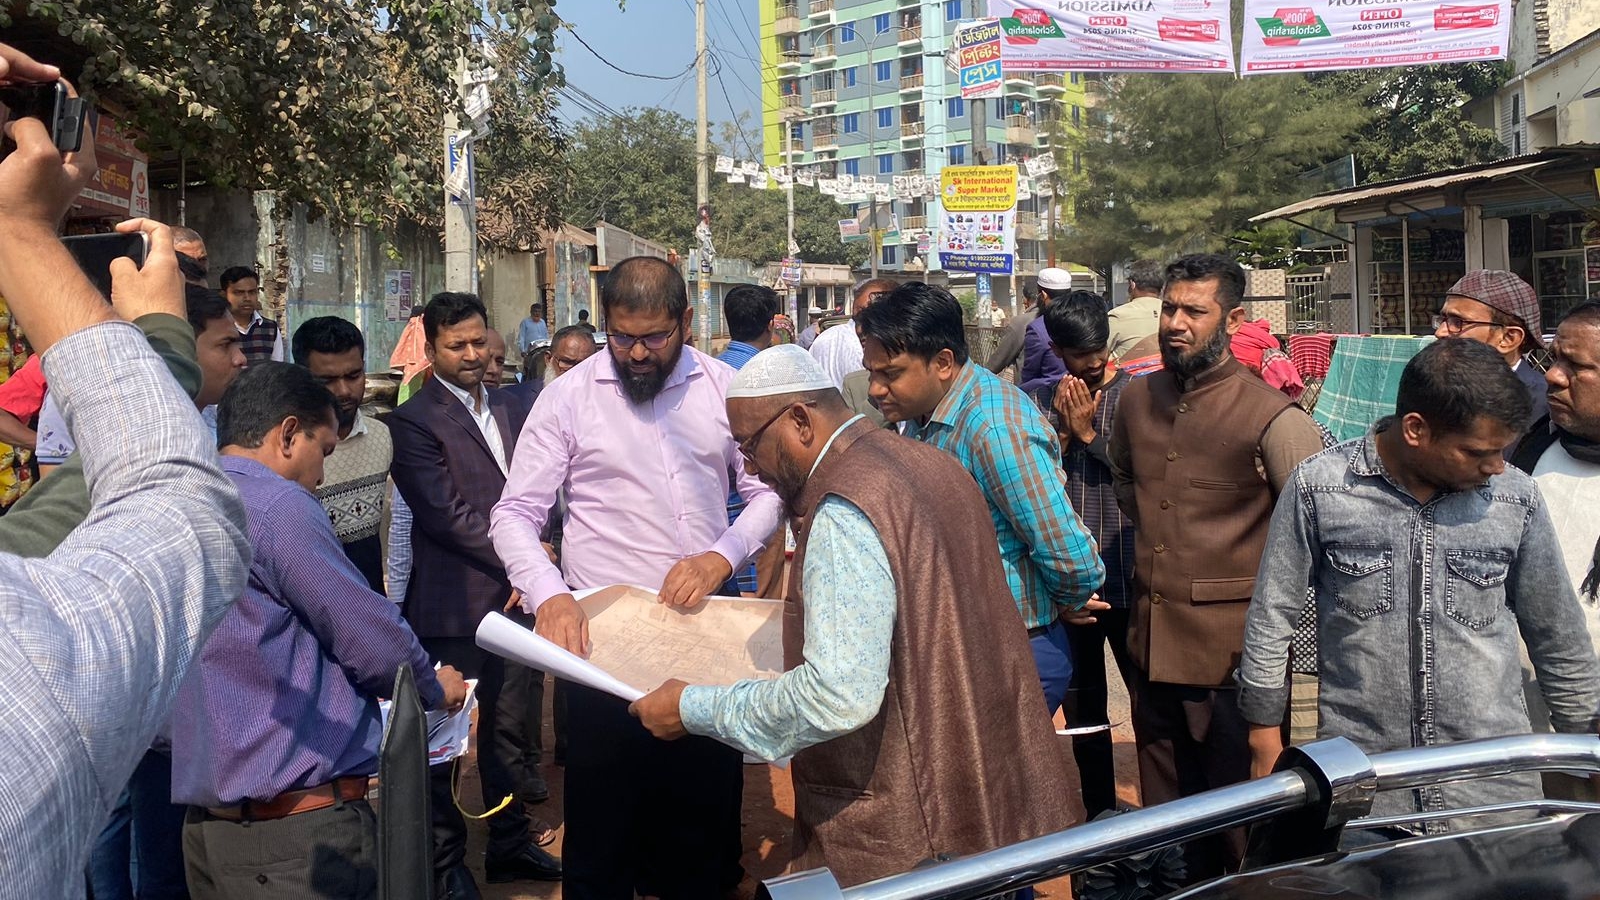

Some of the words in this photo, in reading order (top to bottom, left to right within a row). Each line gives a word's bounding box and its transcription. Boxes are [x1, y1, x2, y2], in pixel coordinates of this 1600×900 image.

[960, 25, 999, 46] ডিজিটাল
[964, 62, 998, 85] প্রেস
[953, 177, 962, 185] Sk
[964, 176, 1013, 185] International
[957, 186, 979, 195] Super
[980, 185, 1007, 194] Market
